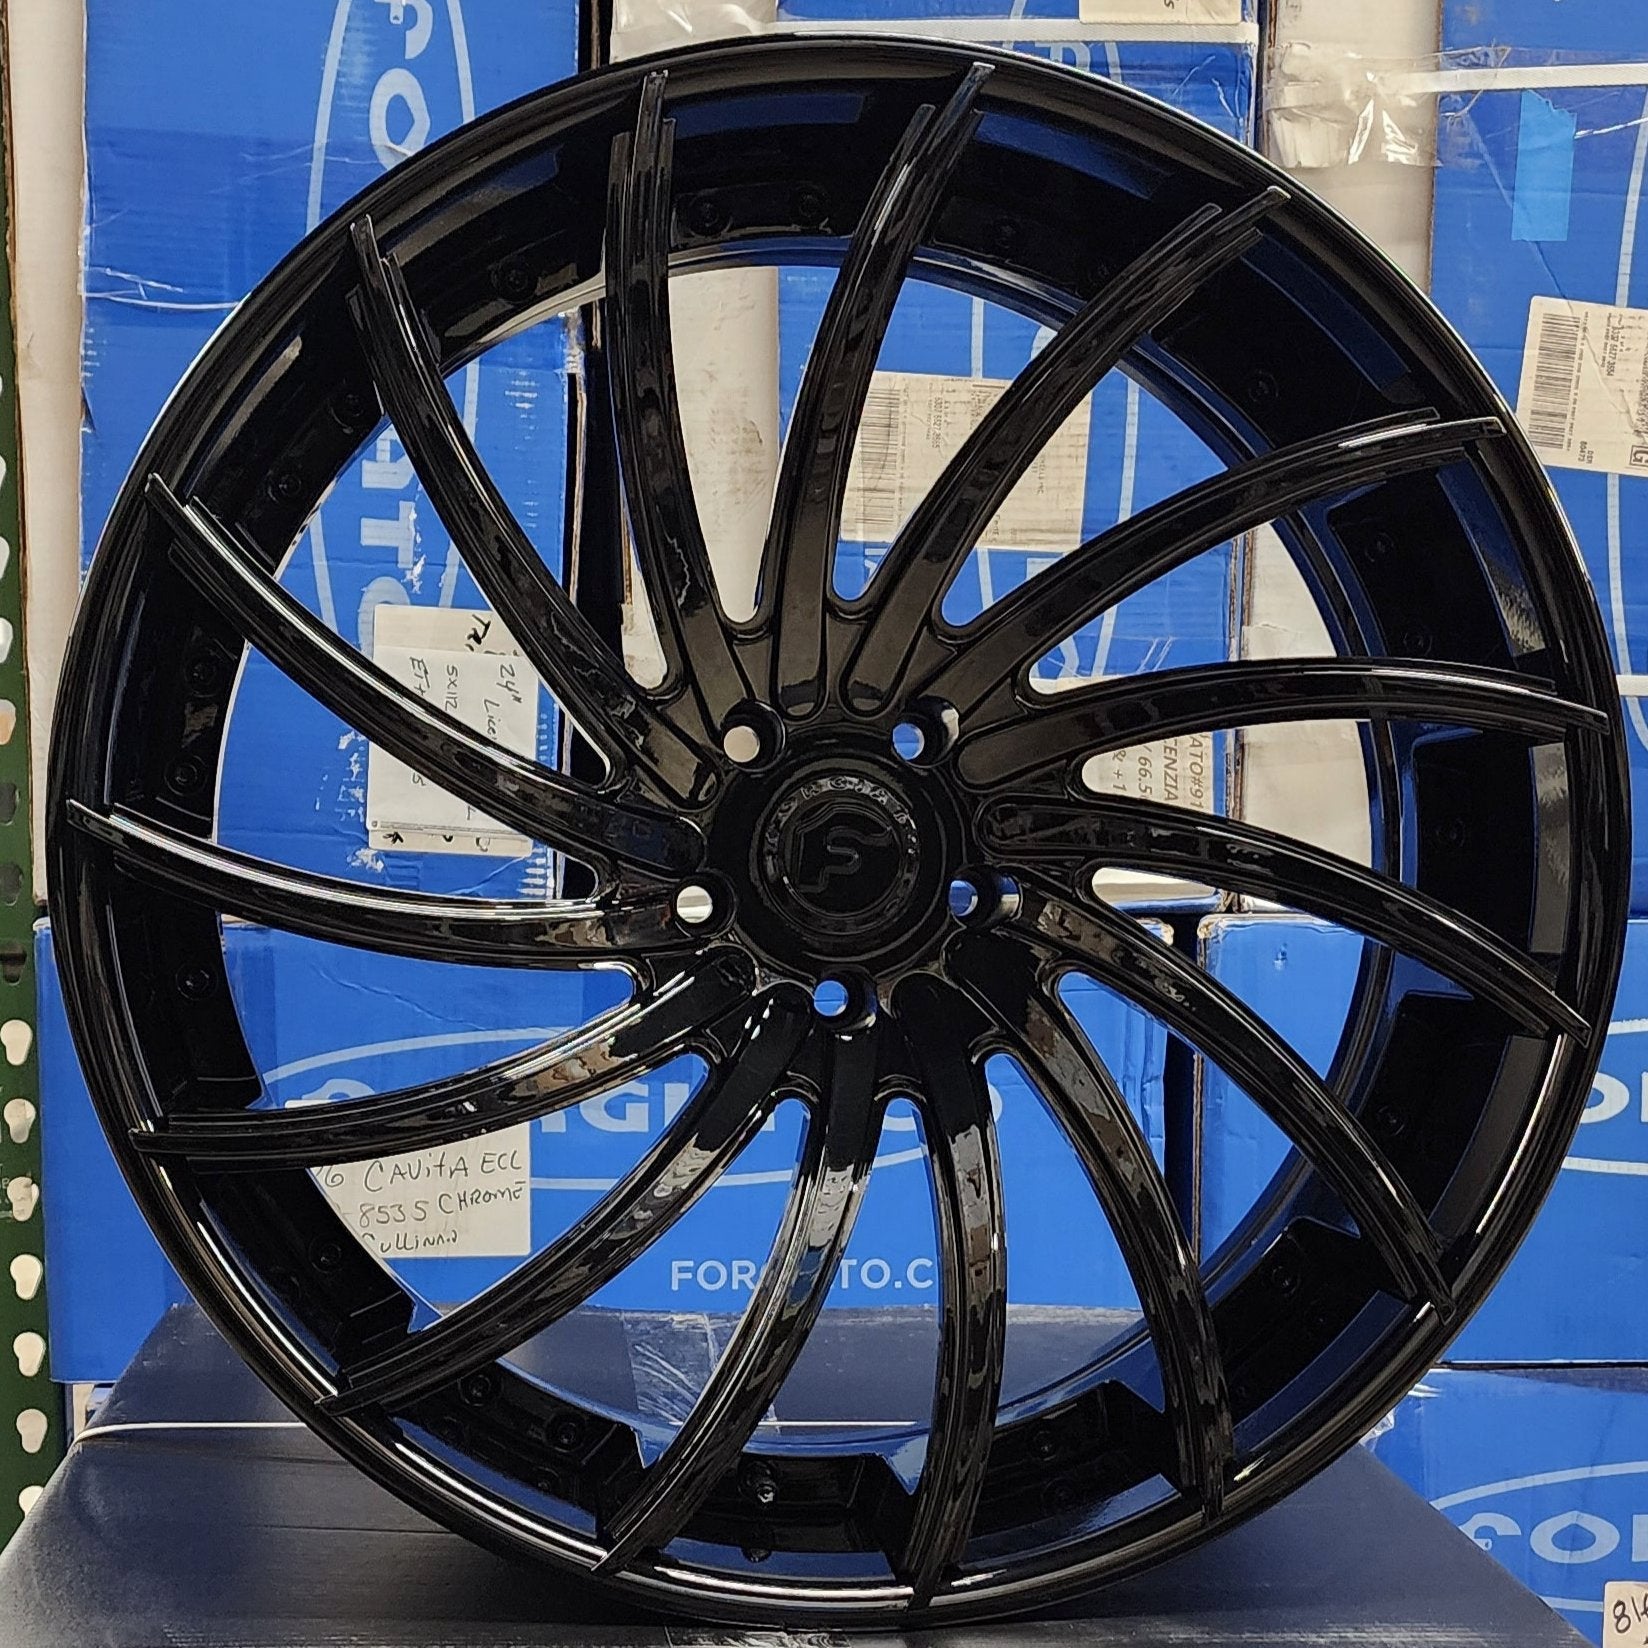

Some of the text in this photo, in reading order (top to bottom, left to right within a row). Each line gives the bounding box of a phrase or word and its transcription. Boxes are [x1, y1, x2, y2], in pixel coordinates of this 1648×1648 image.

[1138, 756, 1152, 798] 66.5
[1189, 735, 1204, 809] ATO#91
[671, 1258, 933, 1291] FORTO.C
